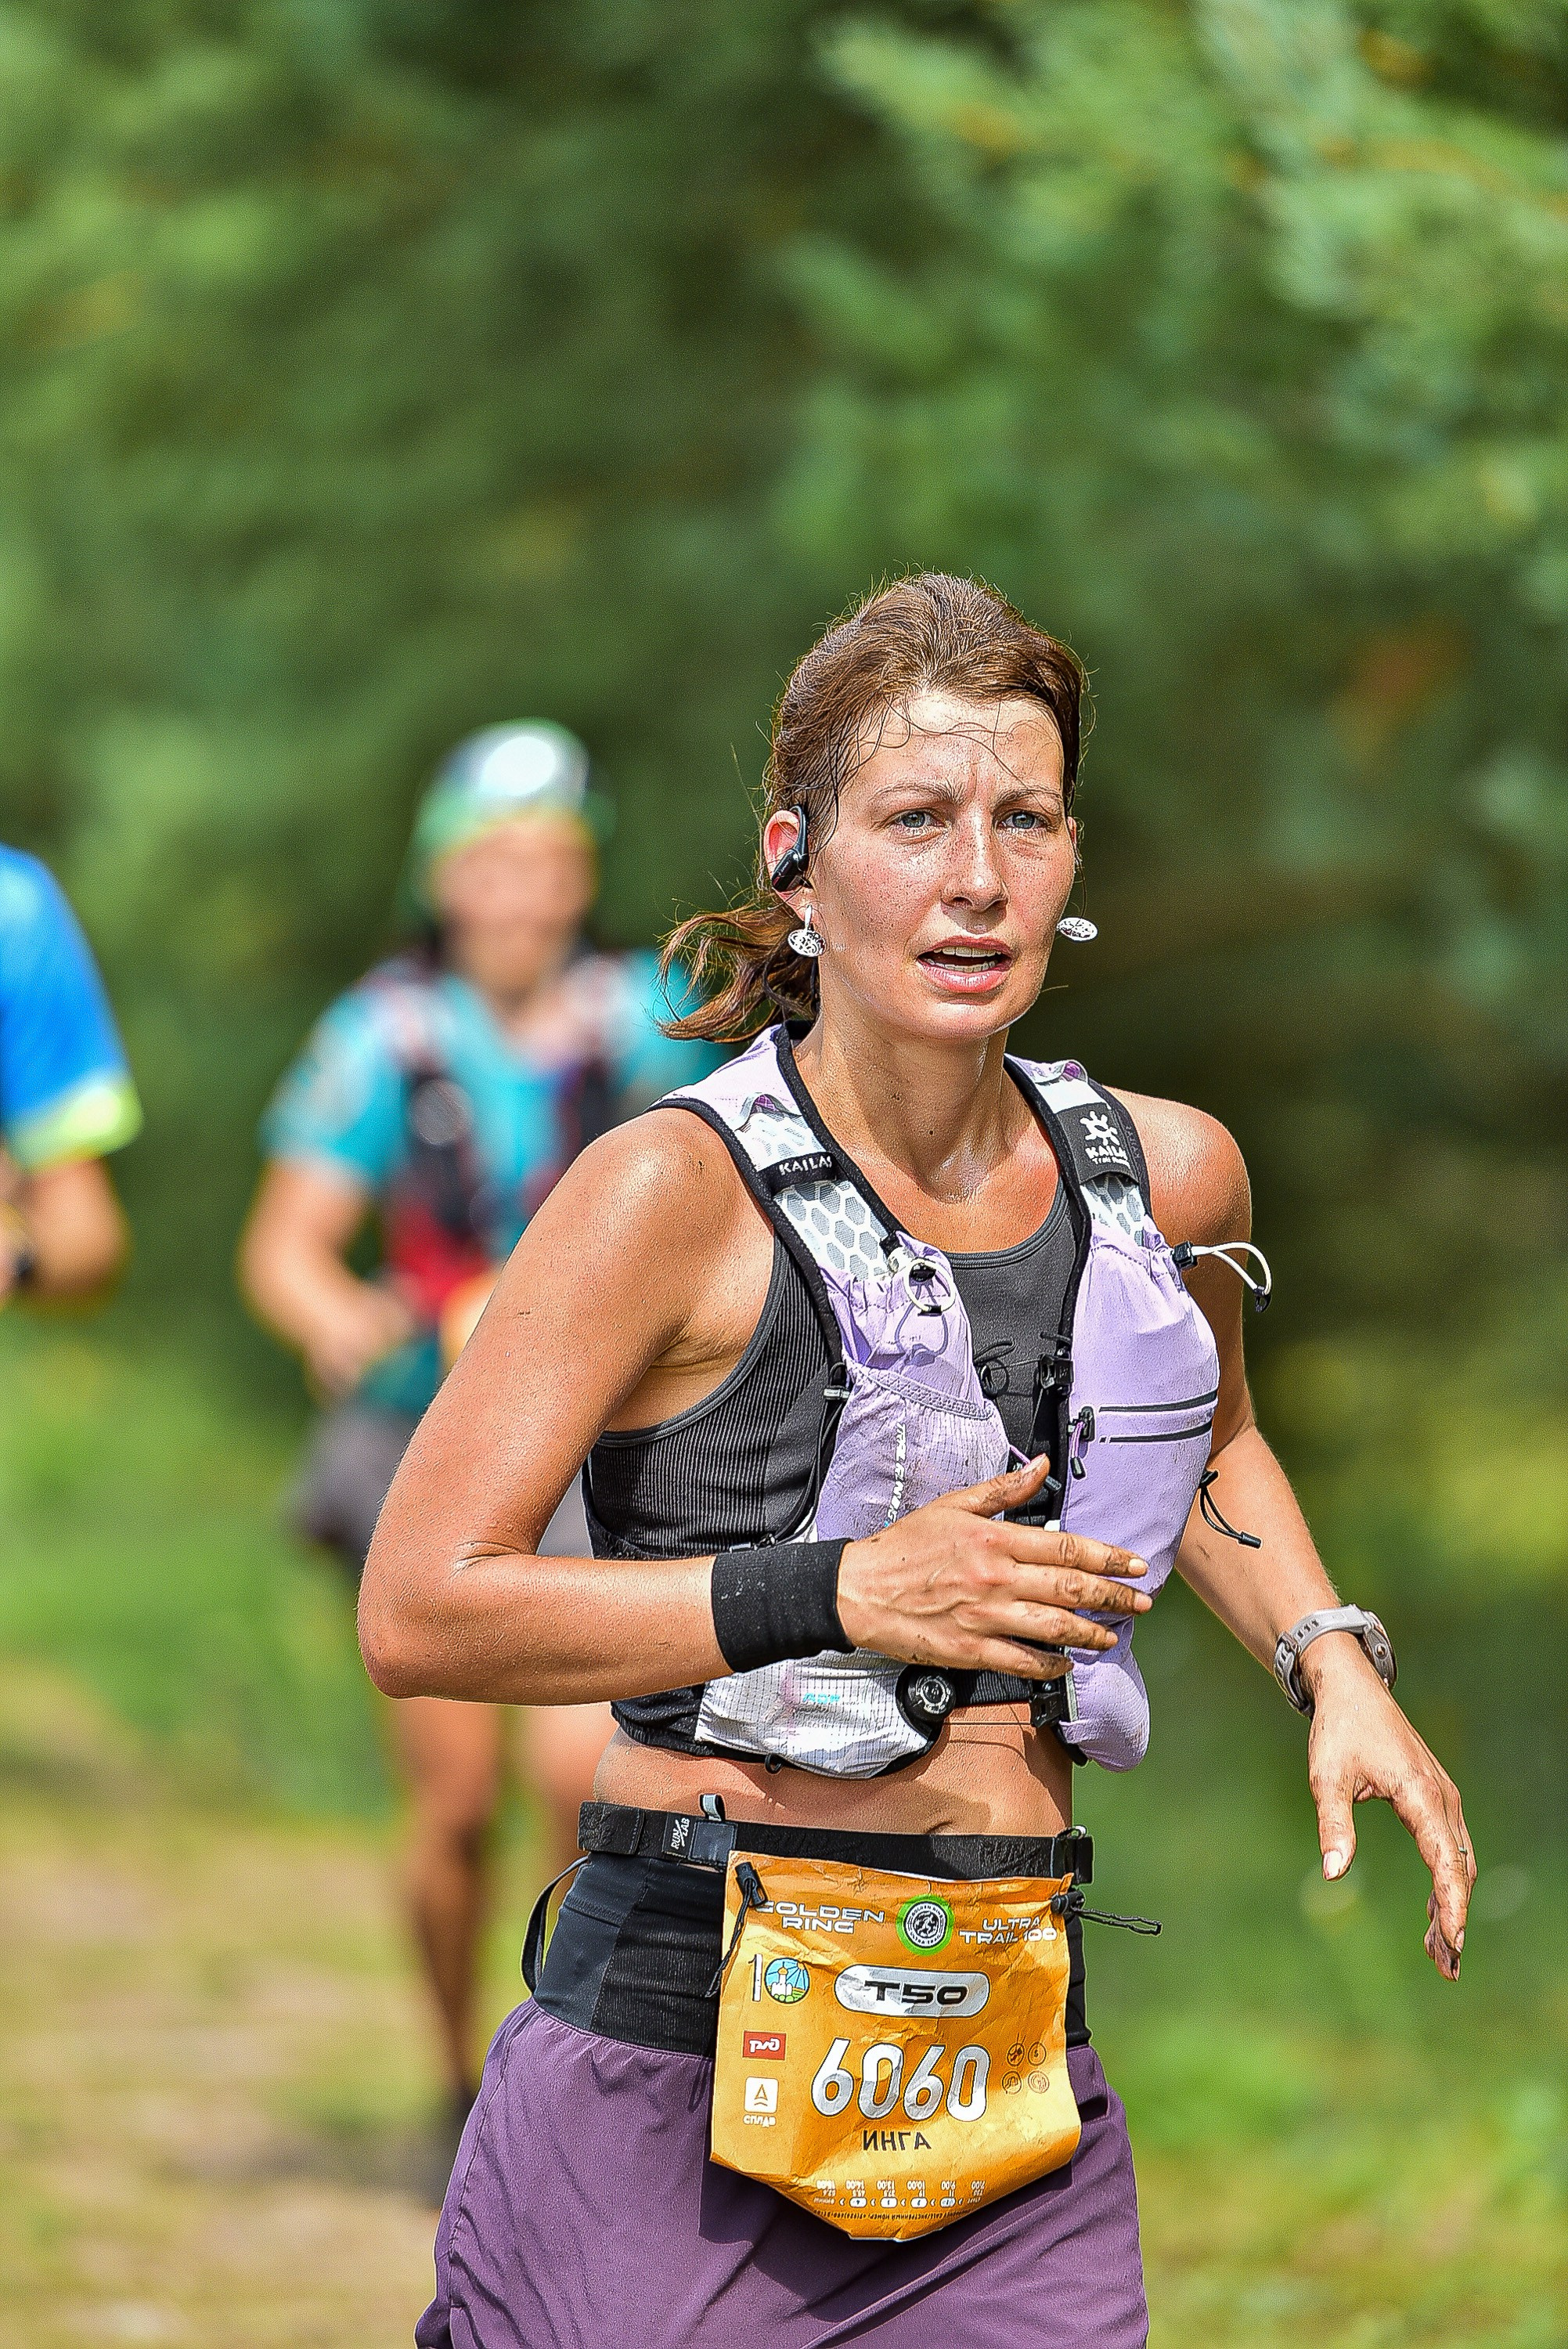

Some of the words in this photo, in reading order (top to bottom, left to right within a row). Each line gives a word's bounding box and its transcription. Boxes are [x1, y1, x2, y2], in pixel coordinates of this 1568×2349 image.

[680, 1817, 690, 1837] LAB
[671, 1828, 681, 1850] RUN
[755, 1900, 885, 1924] GOLDEN
[781, 1916, 854, 1934] RING
[982, 1916, 1040, 1932] ULTRA
[958, 1929, 1018, 1944] TRAIL
[1022, 1927, 1058, 1942] 100
[864, 1979, 968, 2005] T50
[811, 2037, 991, 2122] 6060
[863, 2129, 932, 2152] ИНГА
